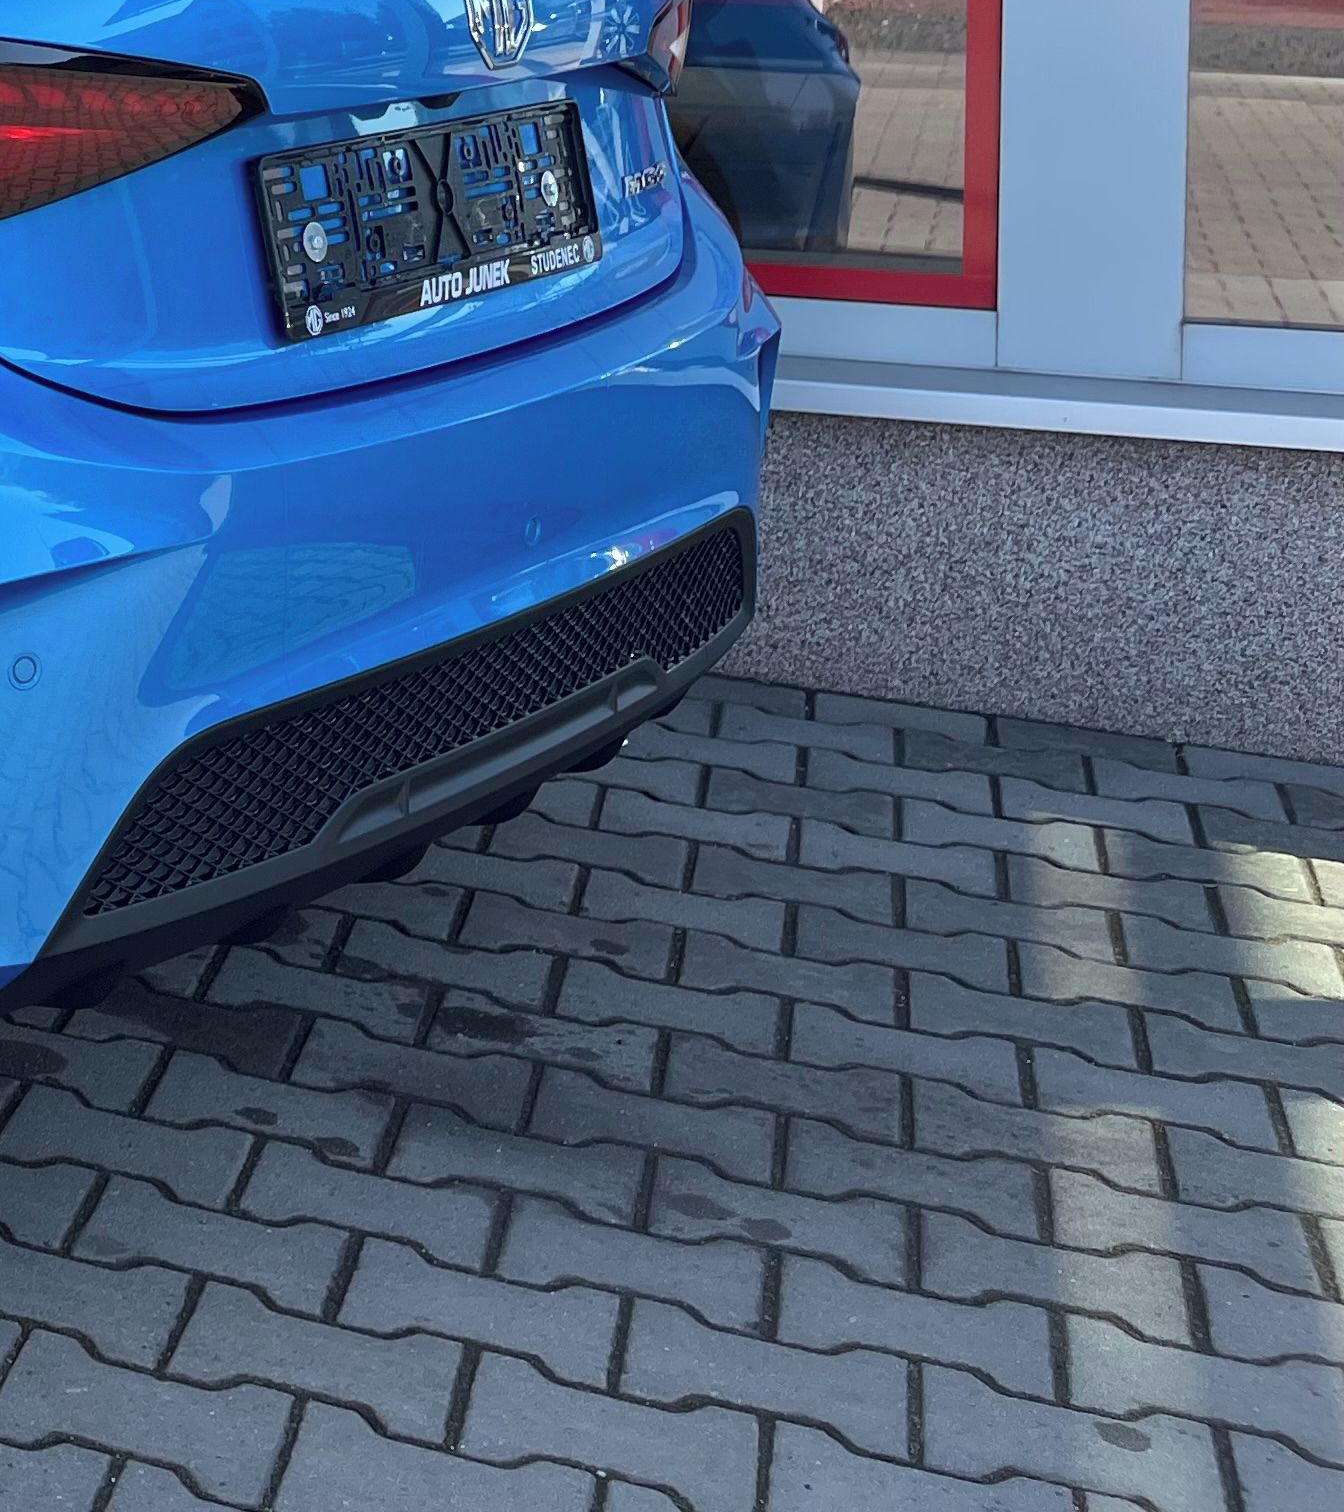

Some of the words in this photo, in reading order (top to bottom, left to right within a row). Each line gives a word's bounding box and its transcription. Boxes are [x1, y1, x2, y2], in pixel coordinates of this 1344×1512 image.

[530, 244, 580, 276] STUDENEC
[420, 272, 463, 307] AUTO
[465, 259, 511, 296] JUNEK
[306, 306, 323, 335] MG
[324, 310, 340, 324] Since
[341, 305, 356, 320] 1924
